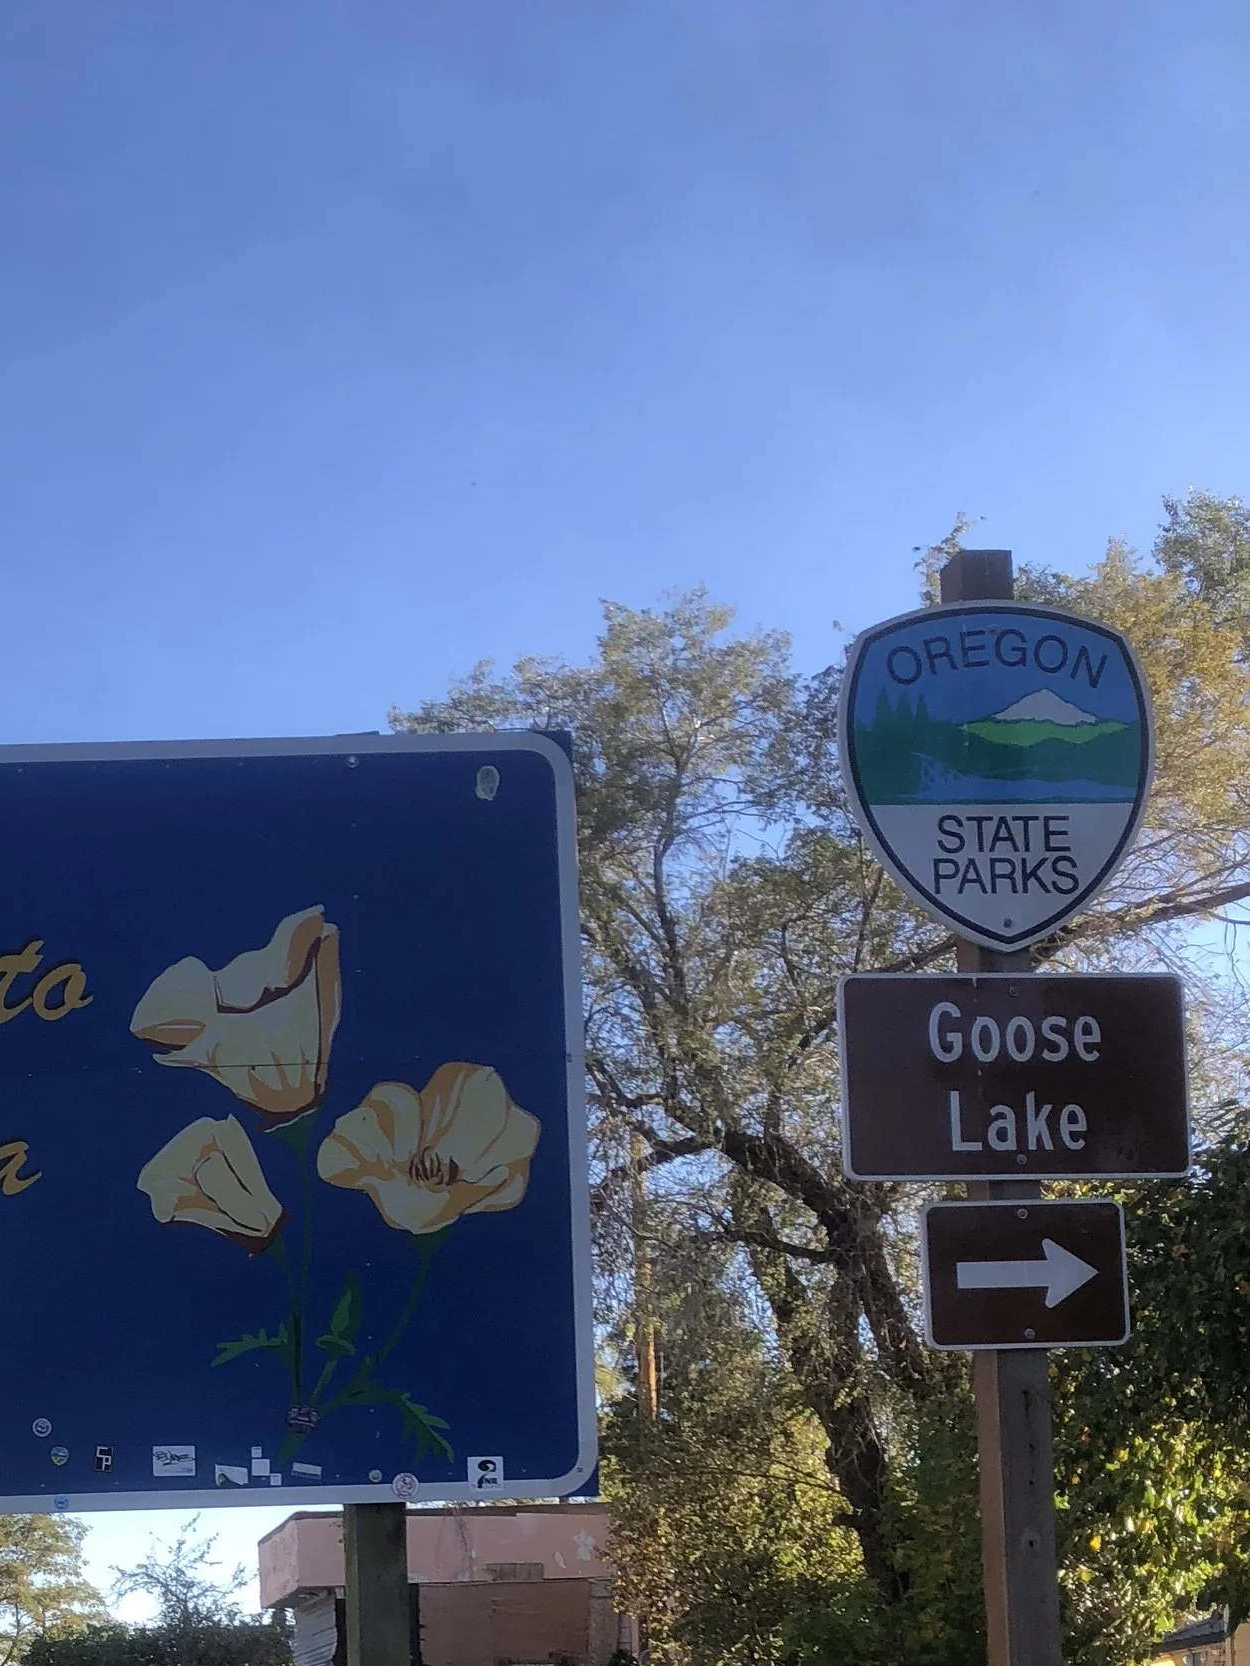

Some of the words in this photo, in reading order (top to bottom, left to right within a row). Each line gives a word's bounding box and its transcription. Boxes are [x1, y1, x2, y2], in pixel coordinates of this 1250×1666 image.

[887, 628, 1108, 689] OREGON
[936, 814, 1072, 854] STATE
[932, 855, 1081, 895] PARKS
[928, 1001, 1101, 1063] Goose
[950, 1090, 1088, 1151] Lake
